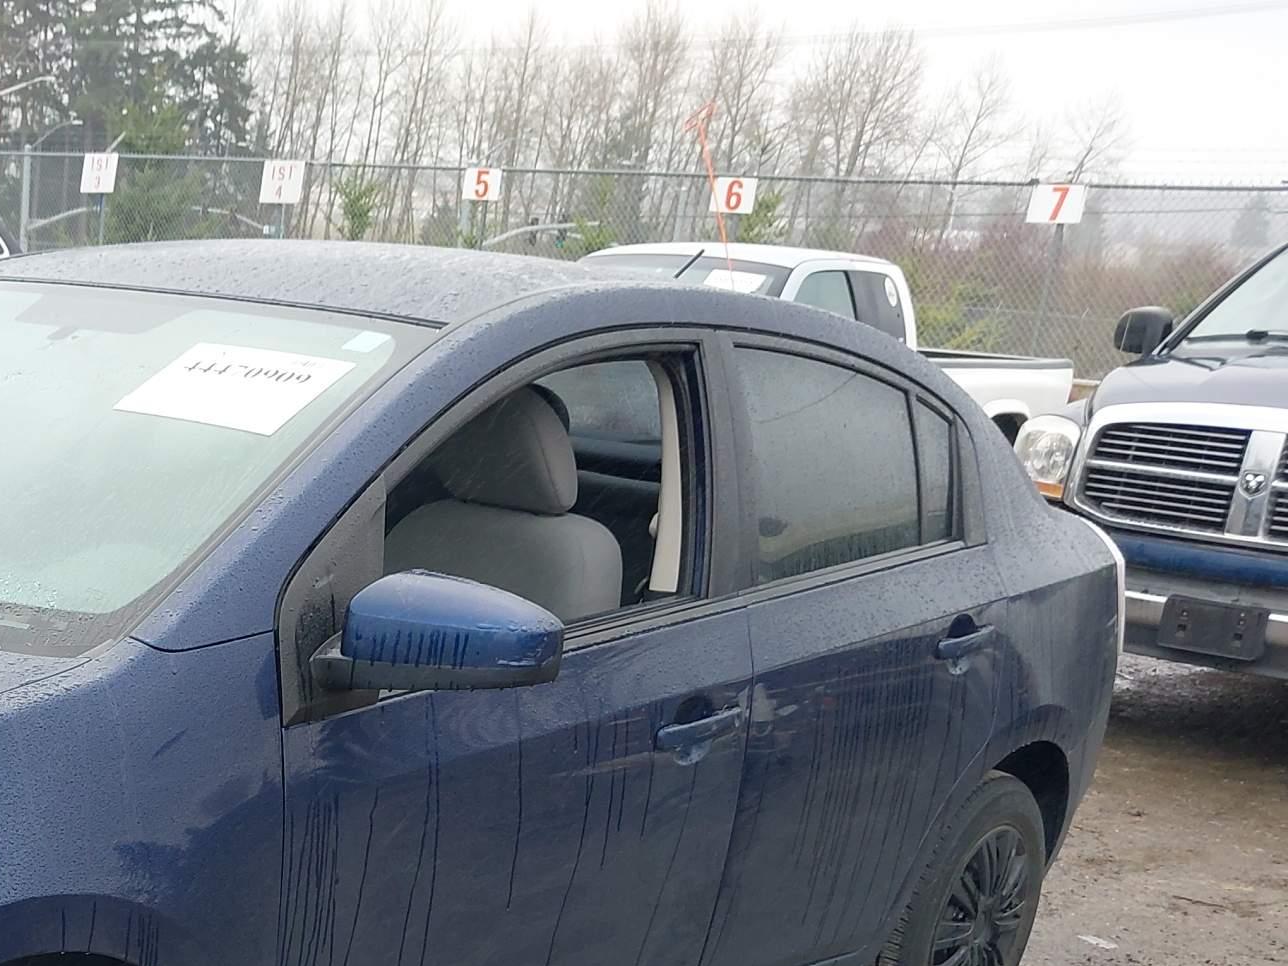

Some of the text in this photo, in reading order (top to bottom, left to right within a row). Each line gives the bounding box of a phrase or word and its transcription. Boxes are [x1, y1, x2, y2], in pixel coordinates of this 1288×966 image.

[474, 170, 490, 198] 5
[725, 179, 744, 210] 6
[1049, 187, 1070, 221] 7
